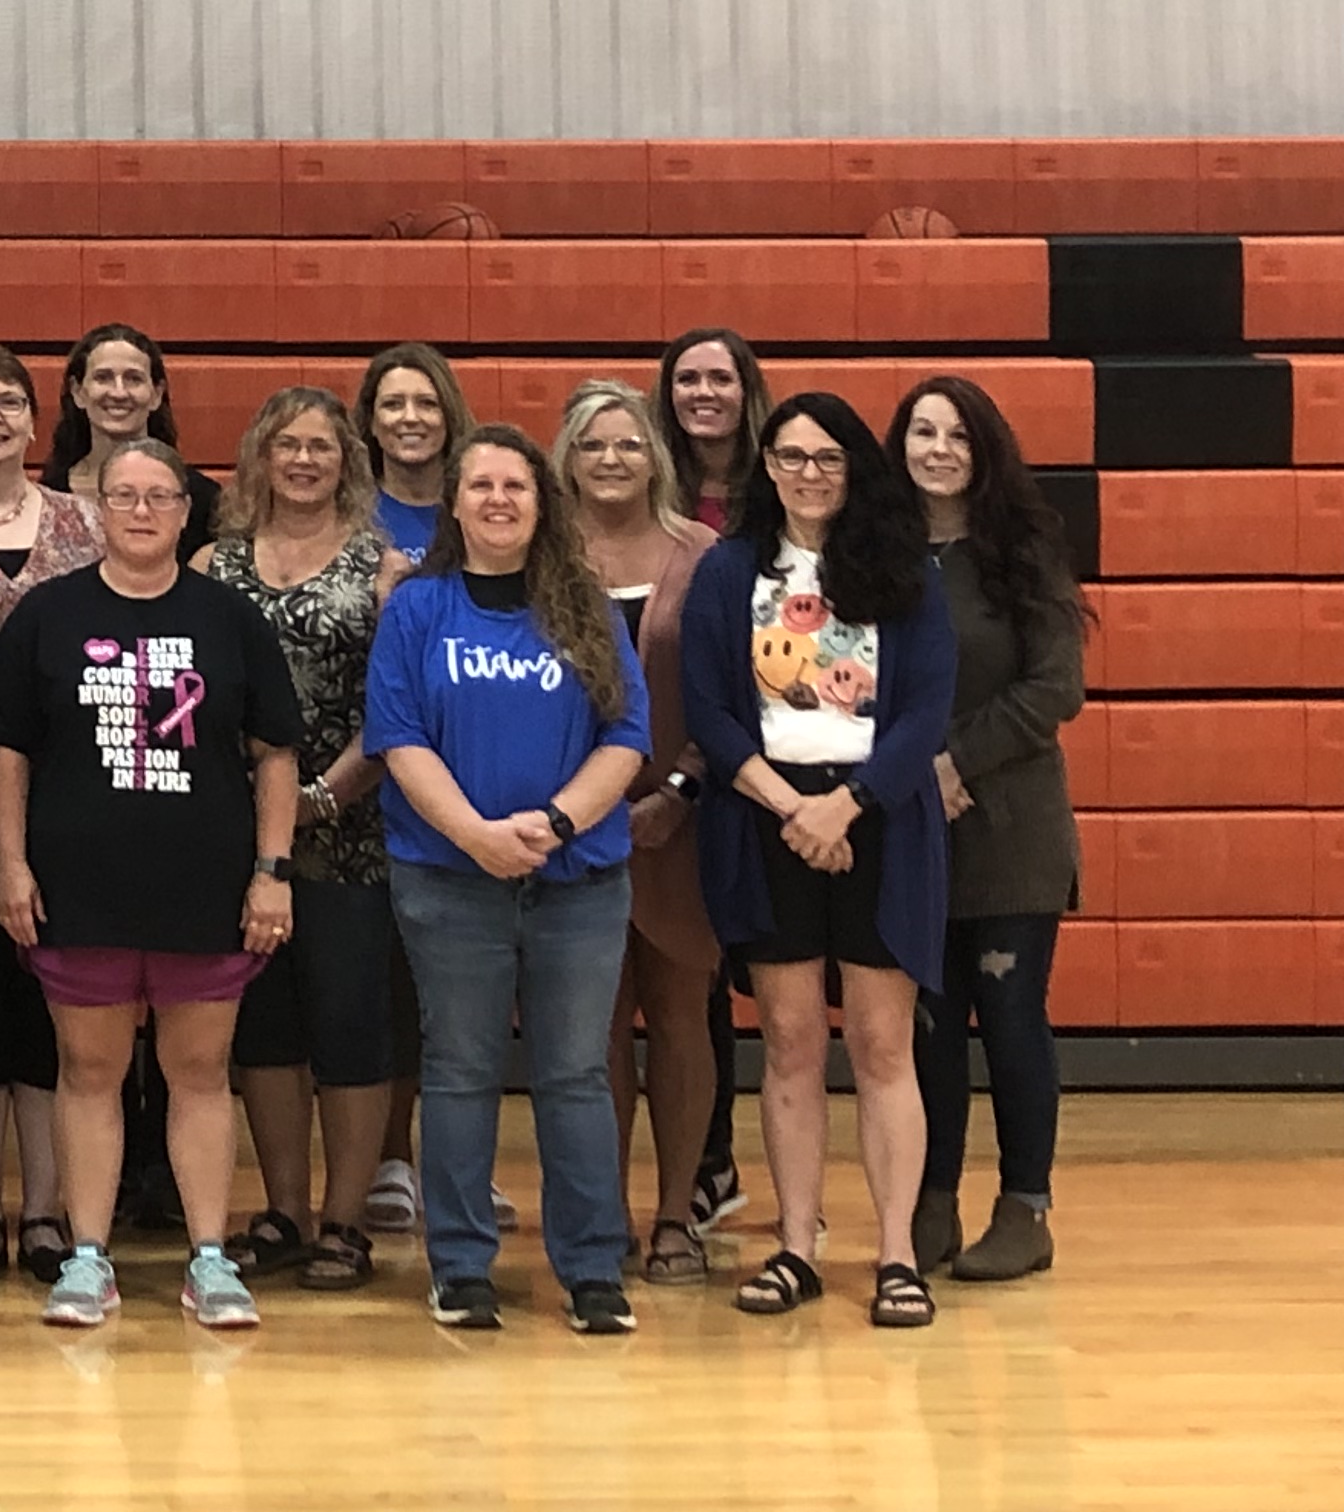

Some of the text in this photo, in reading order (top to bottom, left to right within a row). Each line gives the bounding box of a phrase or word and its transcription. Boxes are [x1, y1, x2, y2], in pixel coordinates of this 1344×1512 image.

[136, 637, 193, 653] FAITH
[122, 652, 193, 669] DESIRE
[83, 666, 175, 687] COURAGE
[78, 684, 150, 705] HUMOR
[98, 706, 148, 726] SOUL
[95, 726, 148, 747] HOPE
[101, 747, 180, 769] PASSION
[112, 769, 191, 792] INSPIRE
